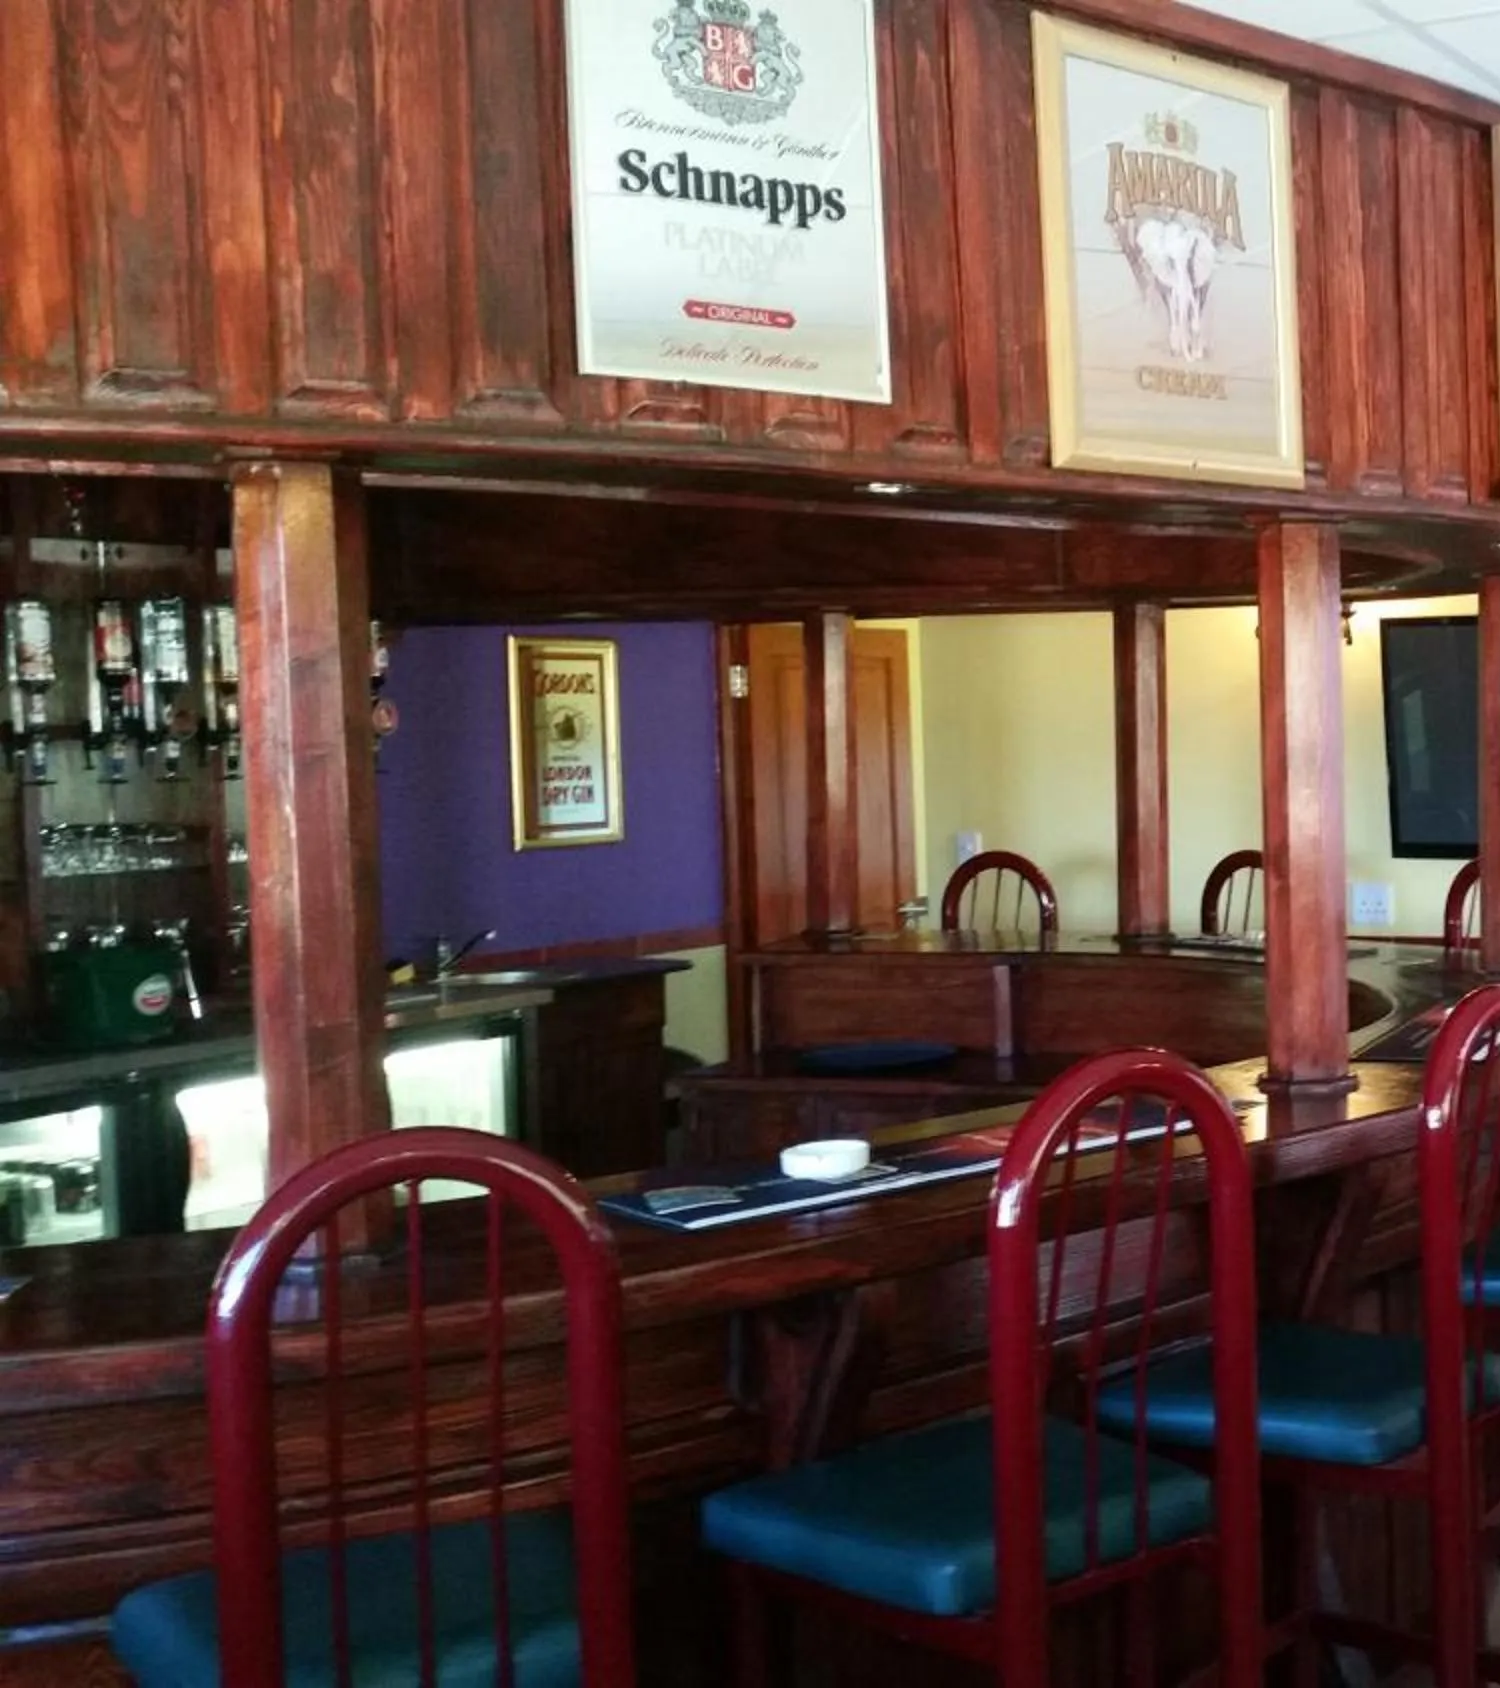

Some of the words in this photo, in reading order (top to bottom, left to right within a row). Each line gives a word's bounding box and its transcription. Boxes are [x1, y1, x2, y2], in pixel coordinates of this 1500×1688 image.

[706, 25, 723, 51] B
[732, 65, 755, 90] G
[617, 147, 847, 229] Schnapps
[1104, 142, 1246, 252] AMARULA
[706, 305, 773, 325] ORIGINAL
[1134, 365, 1228, 401] CREAM
